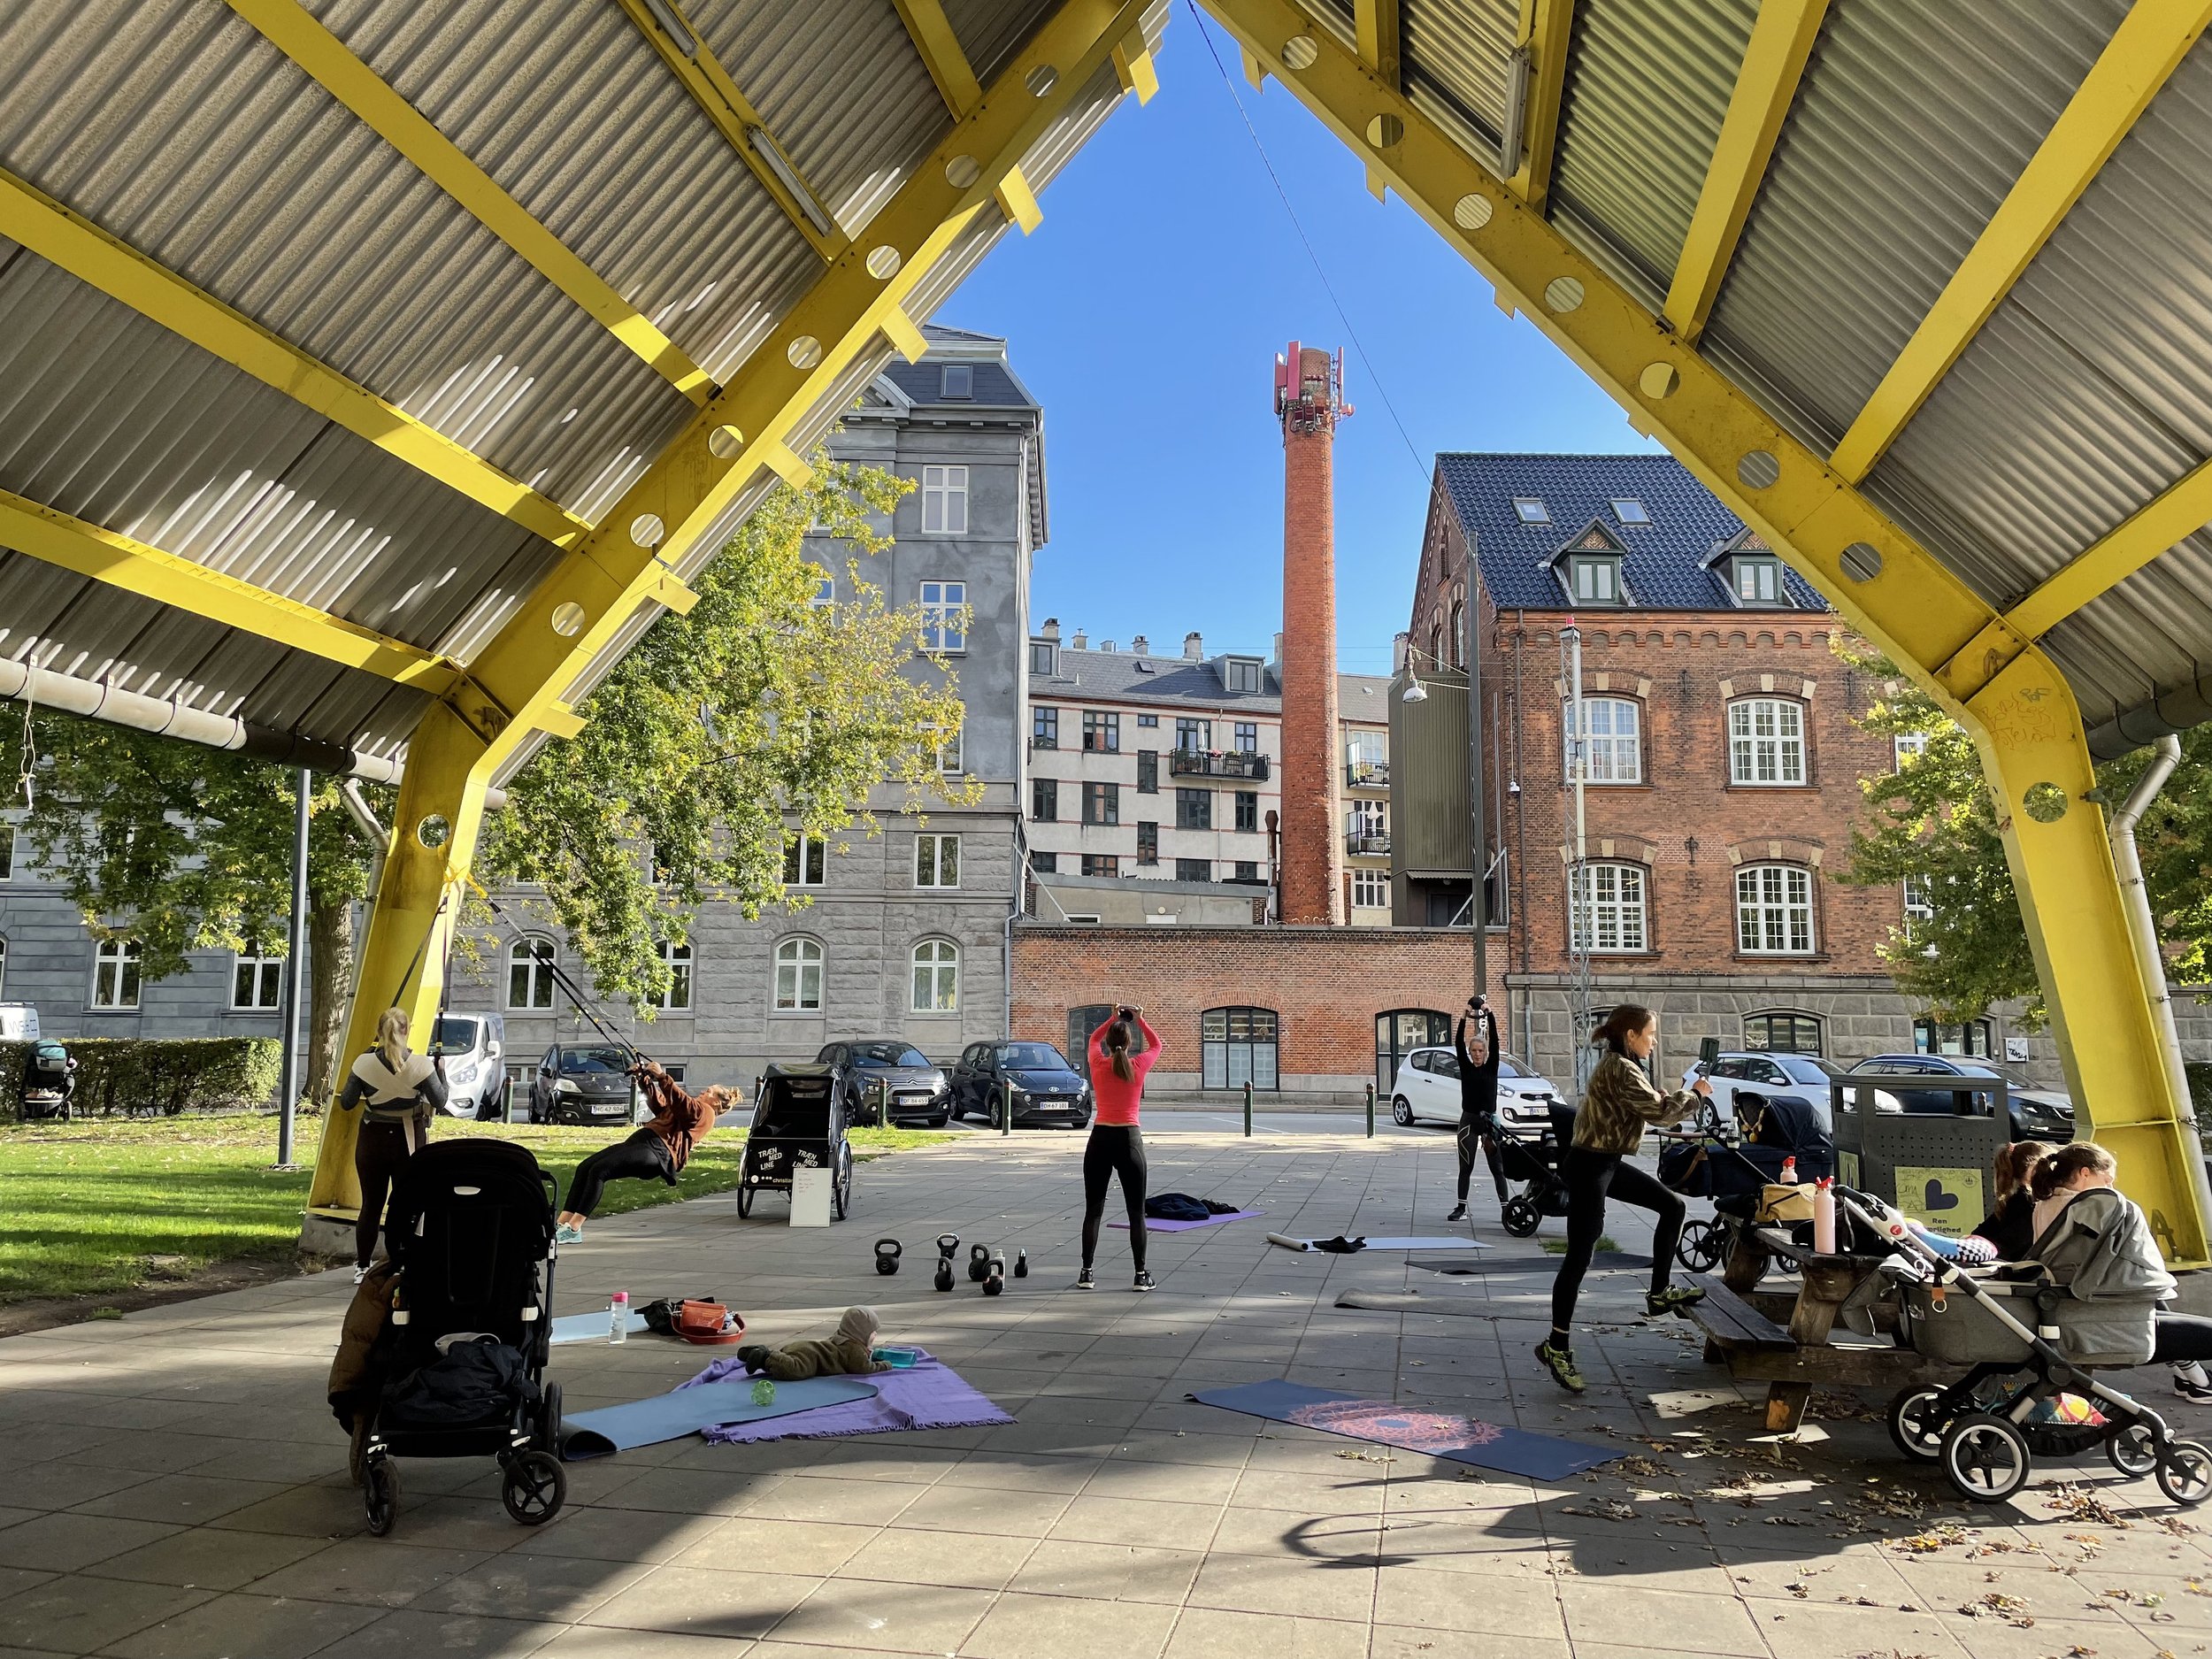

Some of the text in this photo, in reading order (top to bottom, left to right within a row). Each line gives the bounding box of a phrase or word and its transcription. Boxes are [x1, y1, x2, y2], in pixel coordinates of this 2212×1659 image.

[758, 1147, 778, 1158] TRÆN
[769, 1152, 782, 1161] MED
[797, 1149, 818, 1160] TRÆN
[760, 1161, 774, 1170] LINE
[803, 1158, 818, 1167] MED
